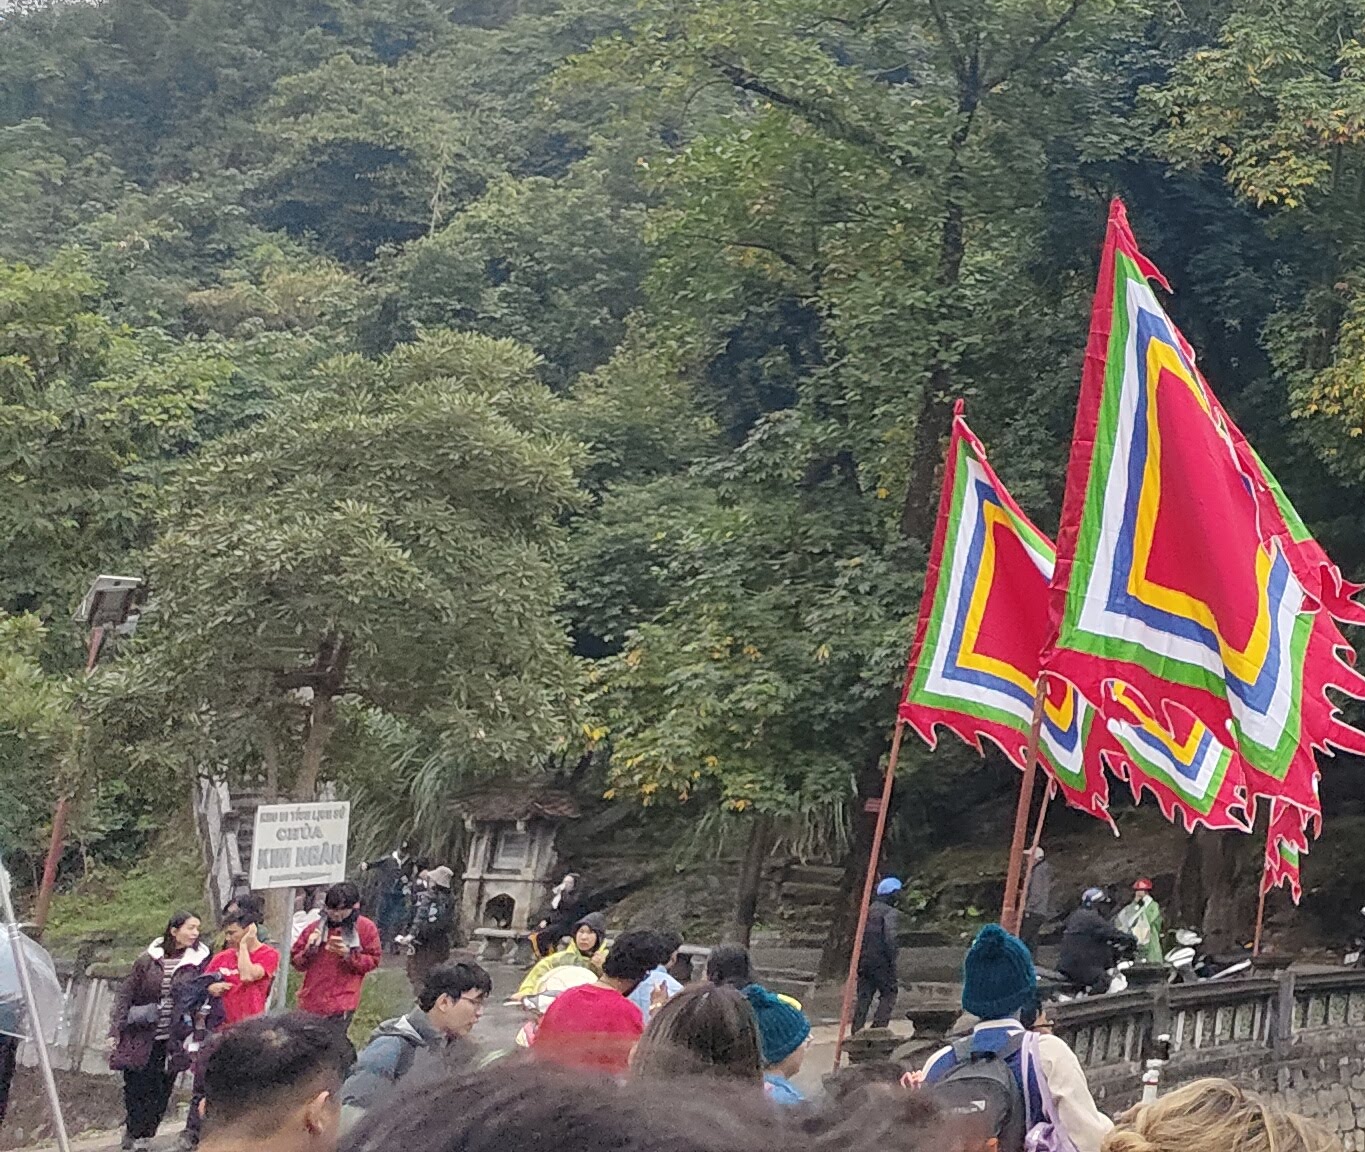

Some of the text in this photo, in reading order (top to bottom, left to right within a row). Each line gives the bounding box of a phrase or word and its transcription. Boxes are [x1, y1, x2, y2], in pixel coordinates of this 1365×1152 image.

[276, 823, 323, 841] CHÙA
[257, 841, 344, 869] KIM NGÂN
